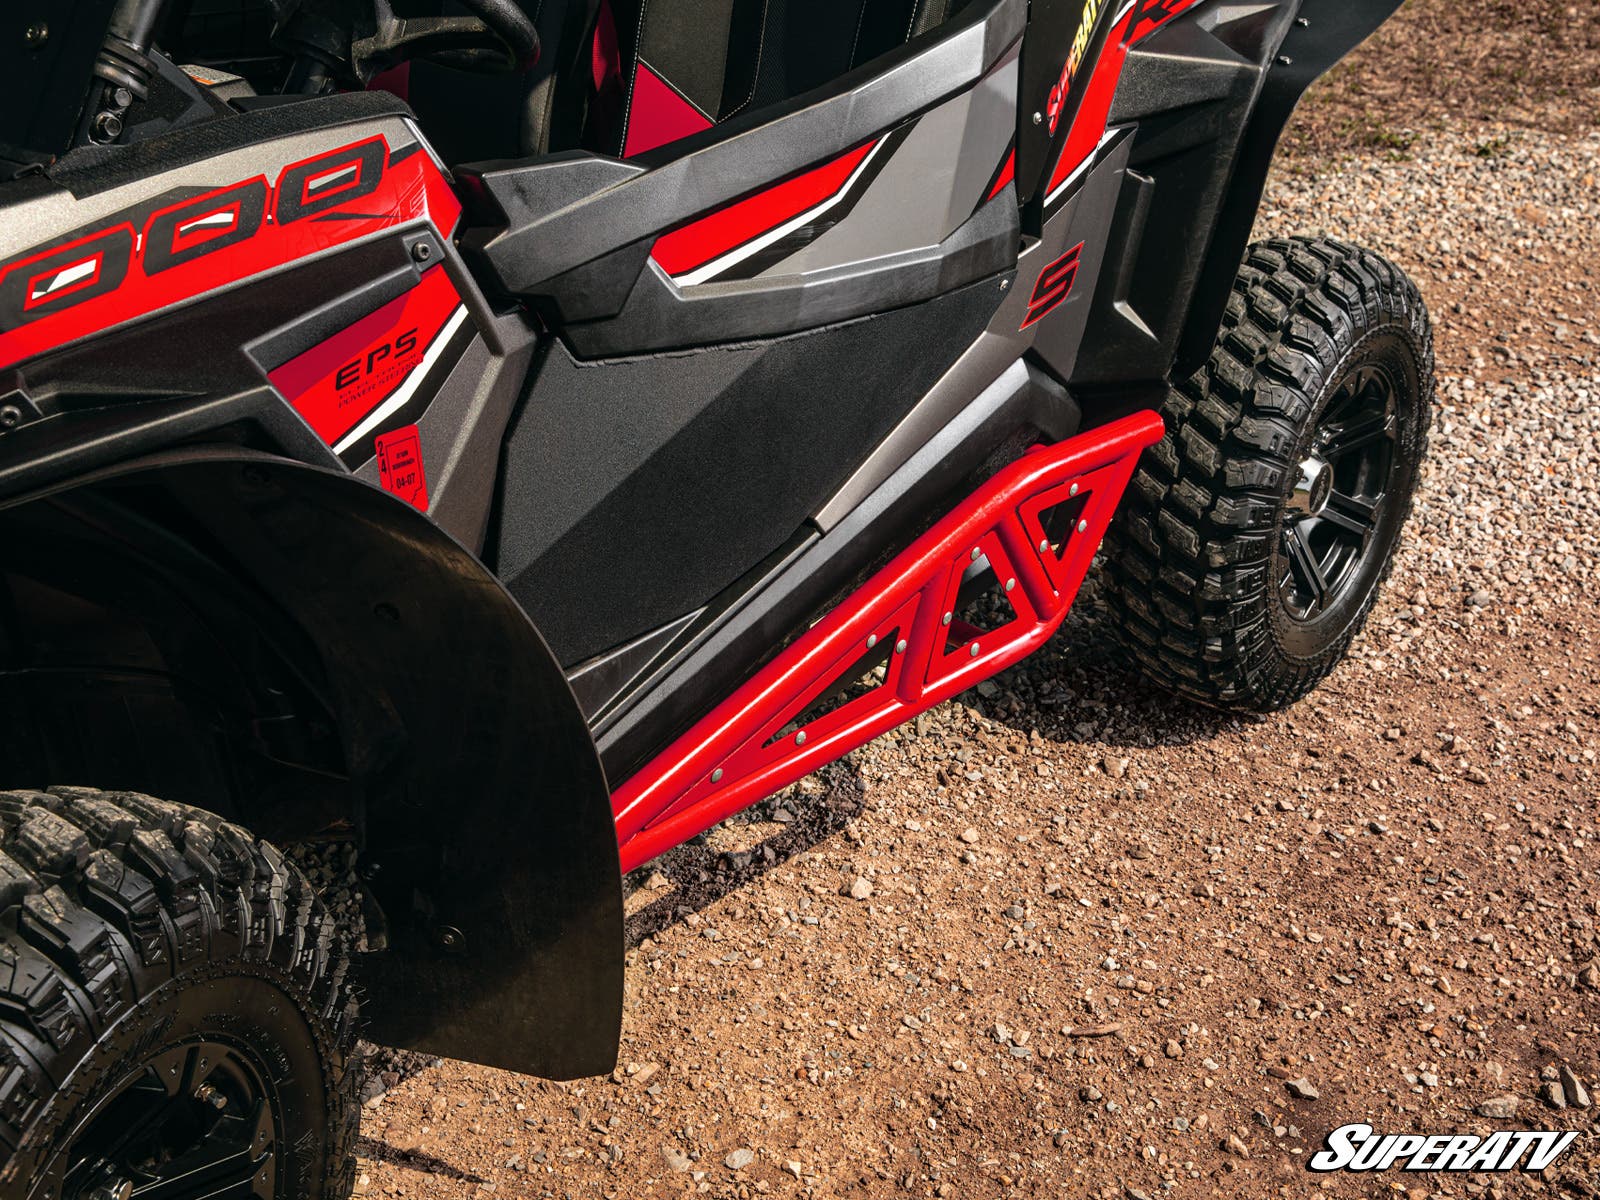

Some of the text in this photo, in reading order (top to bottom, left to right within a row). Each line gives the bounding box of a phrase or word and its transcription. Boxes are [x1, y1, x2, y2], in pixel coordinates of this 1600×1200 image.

[1047, 0, 1101, 136] SUPERAT
[335, 327, 418, 391] EPS
[396, 472, 416, 490] 04-07
